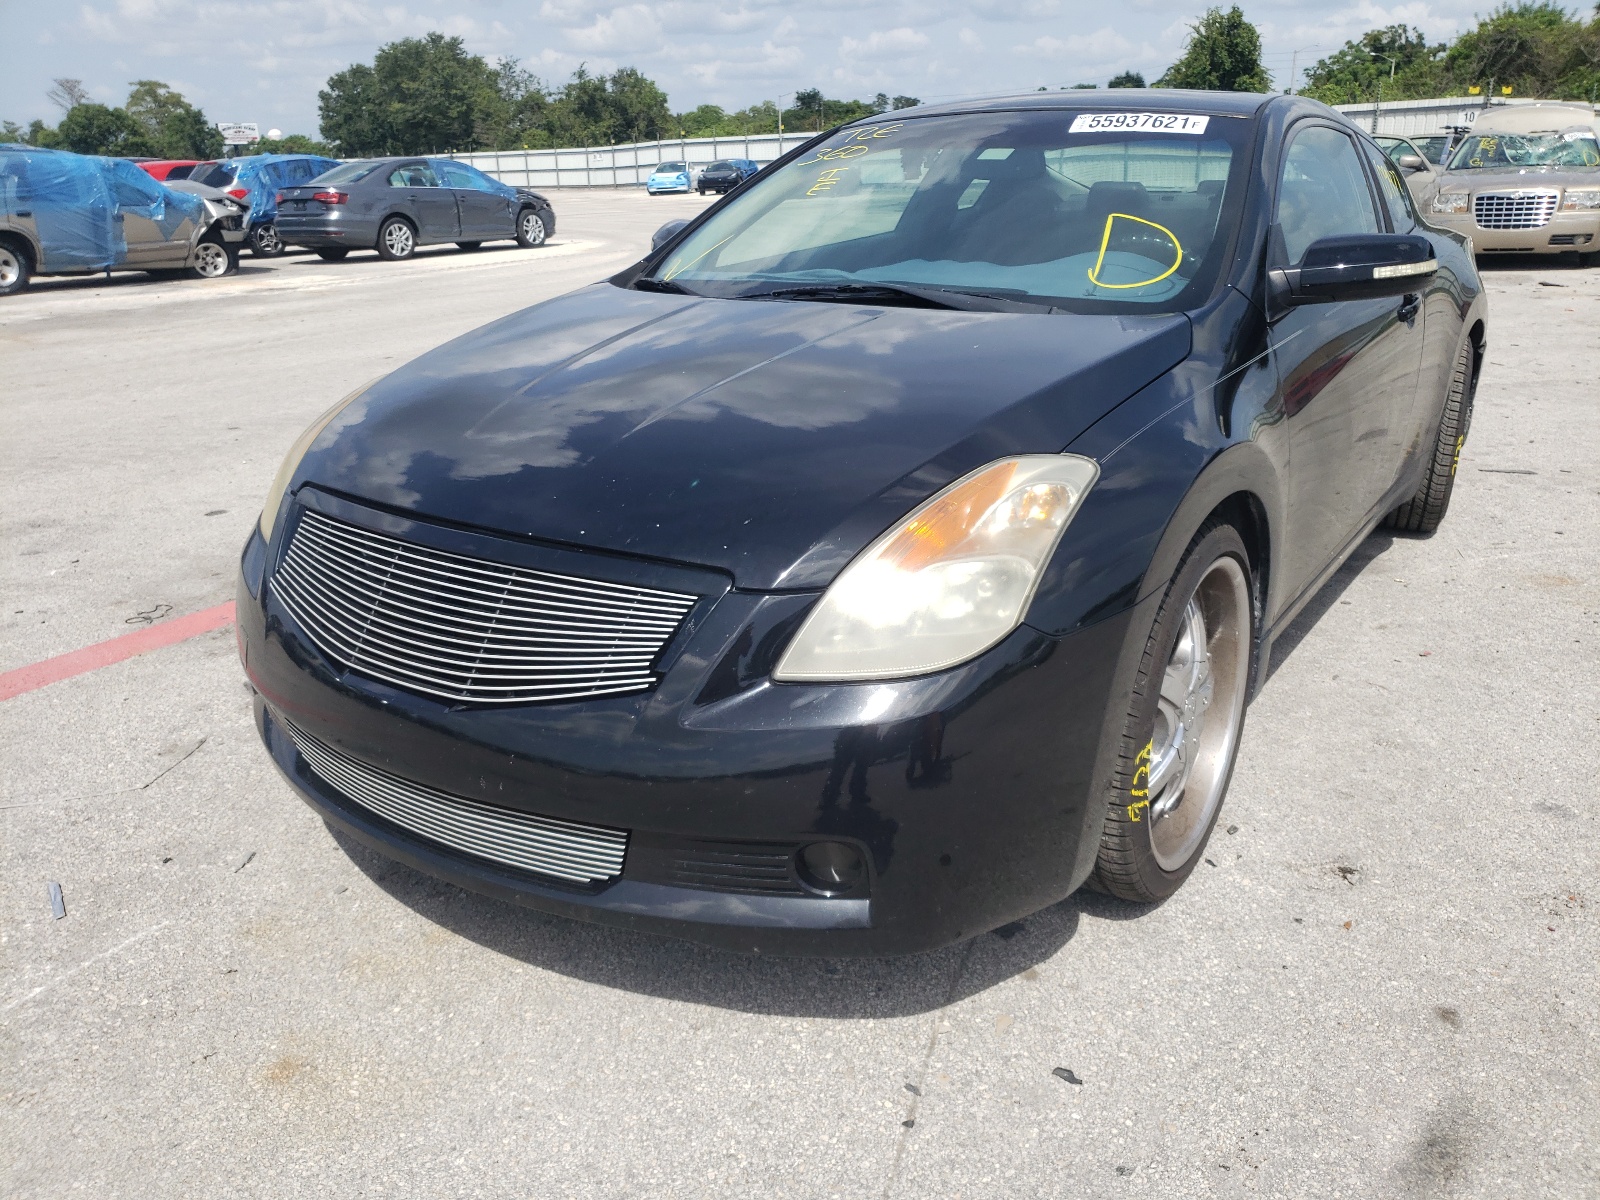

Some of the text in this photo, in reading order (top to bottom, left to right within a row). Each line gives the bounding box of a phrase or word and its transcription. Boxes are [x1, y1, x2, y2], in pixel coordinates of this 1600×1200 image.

[1088, 114, 1190, 130] 55937621
[1191, 121, 1201, 129] F
[1464, 111, 1475, 123] 10
[1087, 212, 1183, 289] D
